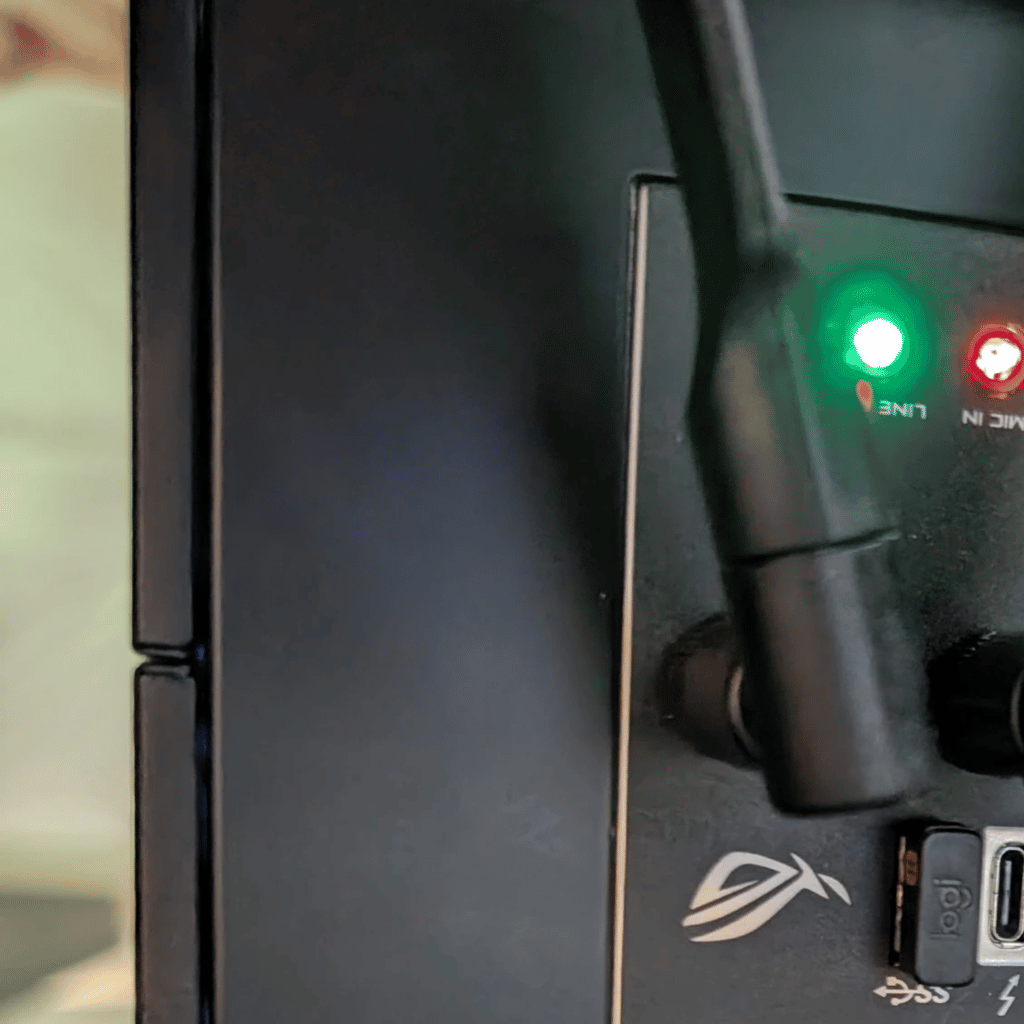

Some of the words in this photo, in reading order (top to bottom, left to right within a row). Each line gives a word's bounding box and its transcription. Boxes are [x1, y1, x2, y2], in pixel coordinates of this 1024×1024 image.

[878, 400, 927, 420] LINE
[961, 408, 984, 427] IN
[929, 876, 974, 940] logi
